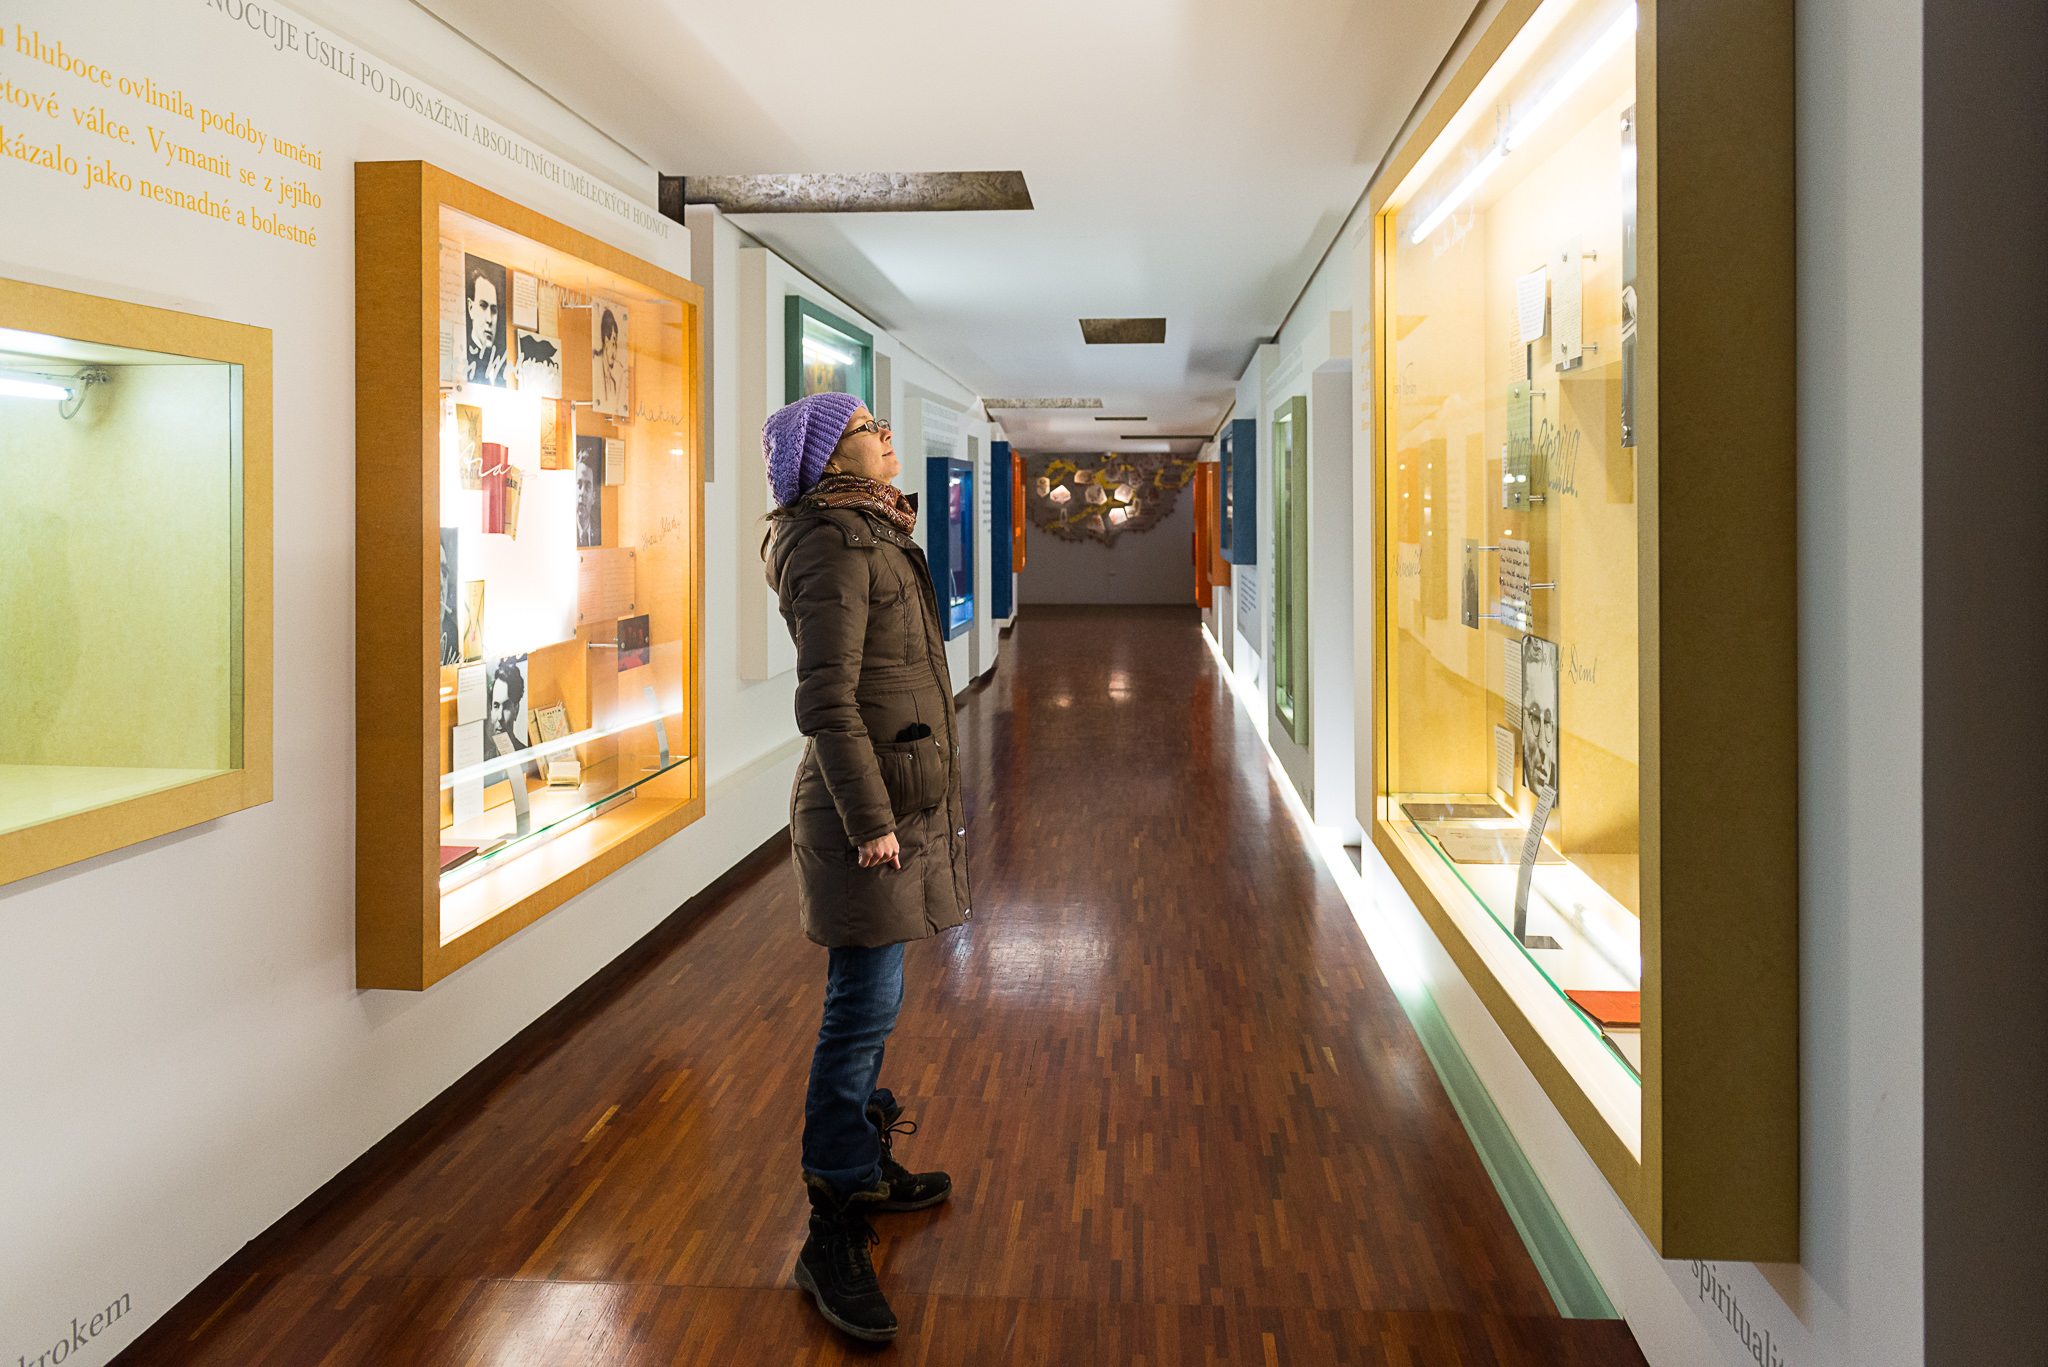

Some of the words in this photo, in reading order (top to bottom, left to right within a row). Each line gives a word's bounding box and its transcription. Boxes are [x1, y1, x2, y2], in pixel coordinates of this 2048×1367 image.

[0, 72, 59, 119] tové
[72, 106, 135, 146] válce.
[146, 125, 232, 179] Vymanit
[239, 167, 256, 187] se
[264, 176, 272, 192] z
[278, 175, 322, 209] jejího
[16, 24, 112, 88] hluboce
[119, 77, 194, 120] ovlinila
[200, 107, 267, 154] podoby
[273, 137, 322, 171] umění
[304, 31, 355, 80] ÚSILÍ
[361, 62, 384, 93] PO
[389, 77, 469, 137] DOSAŽENÍ
[472, 124, 560, 184] ABSOLUTNÍCH
[562, 169, 630, 219] UMĚLECKÝCH
[633, 206, 669, 239] HODNOT
[0, 125, 77, 175] kázalo
[84, 155, 132, 192] jako
[139, 178, 231, 222] nesnadné
[236, 208, 246, 227] a
[251, 206, 317, 247] bolestné
